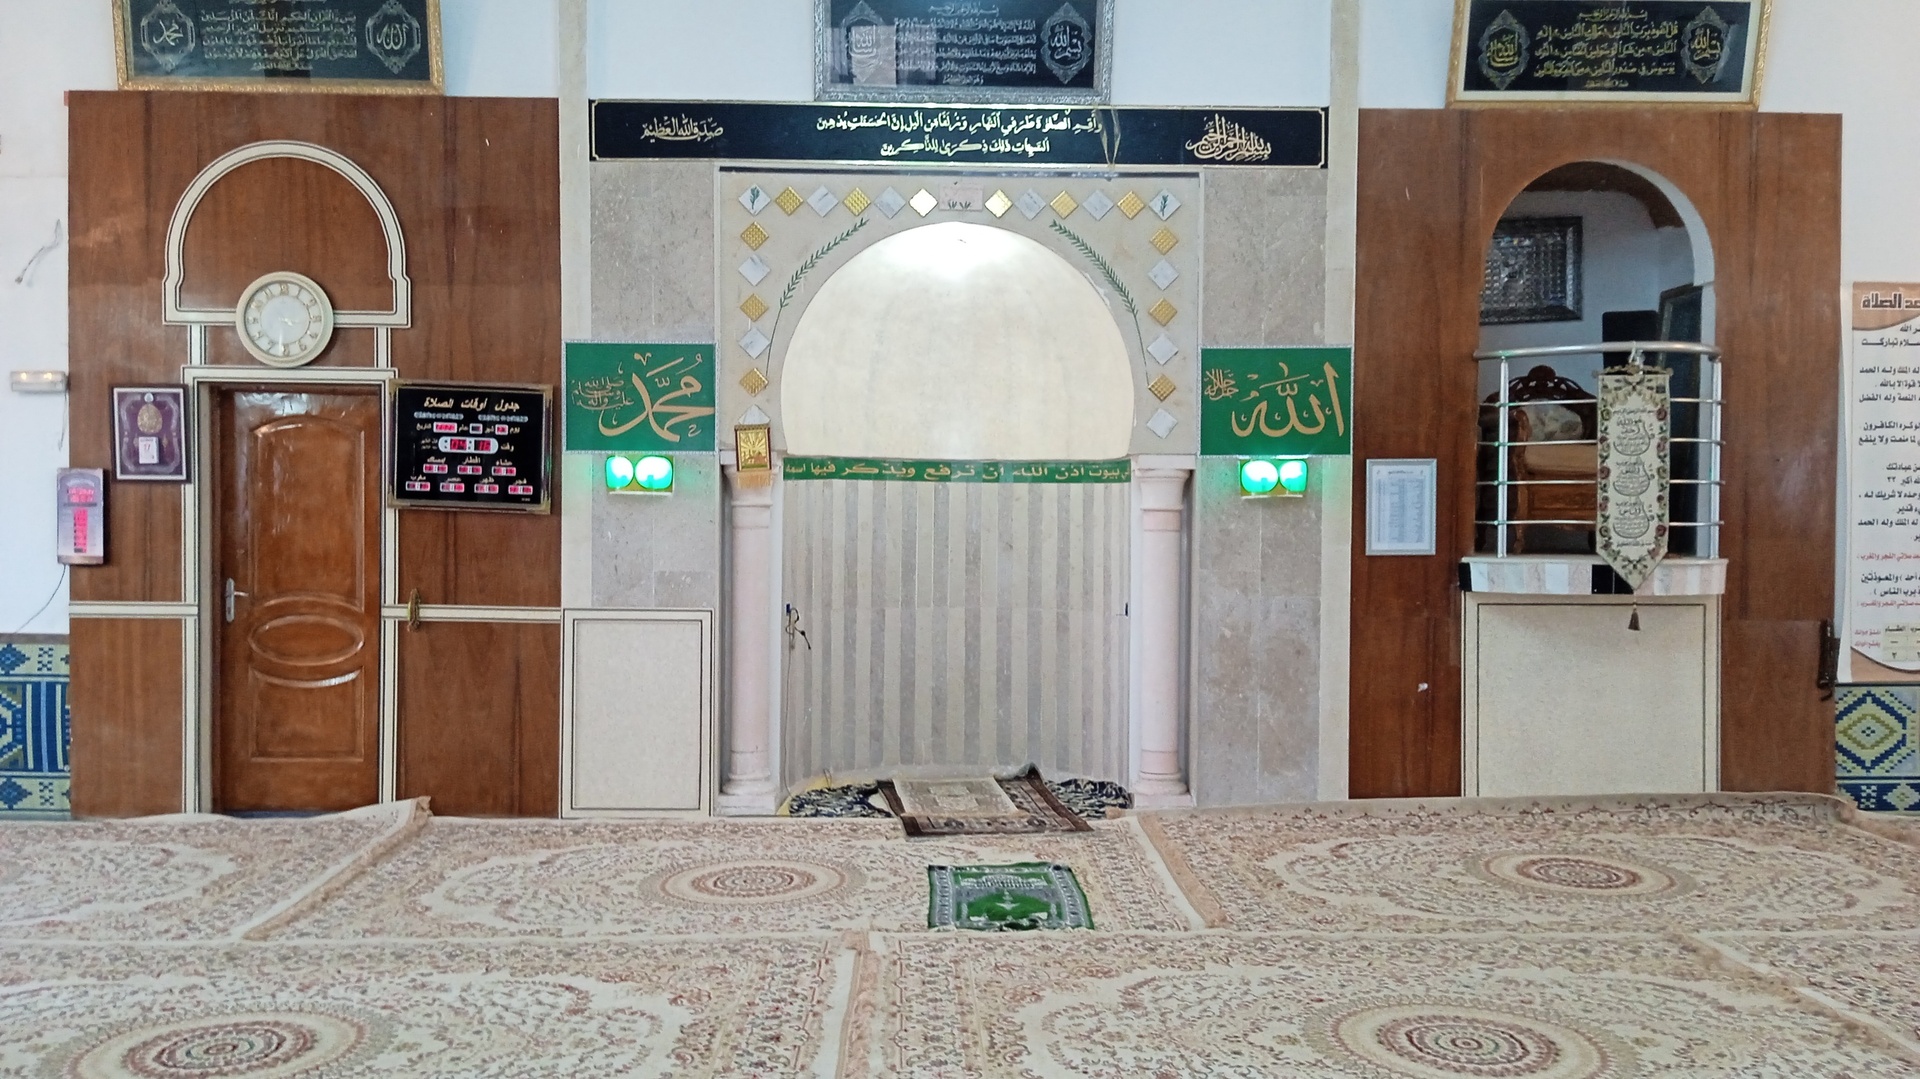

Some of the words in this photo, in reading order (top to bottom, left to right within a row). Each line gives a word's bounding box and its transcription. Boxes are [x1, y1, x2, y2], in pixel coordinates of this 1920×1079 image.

[377, 23, 409, 50] الله
[1050, 26, 1069, 48] الله
[1690, 28, 1709, 48] الله
[969, 111, 1001, 134] النهار
[640, 116, 676, 143] العظيم
[1862, 292, 1902, 309] الصلاة
[1900, 324, 1912, 332] الله
[1861, 337, 1898, 347] تباركت
[1859, 365, 1880, 373] الحمد
[1881, 365, 1896, 375] وله
[424, 397, 454, 409] الصلاة
[599, 354, 715, 442] محمد
[1231, 362, 1345, 437] الله
[1859, 392, 1881, 403] الفضل
[1884, 393, 1896, 403] وله
[495, 399, 521, 412] جدول
[1863, 420, 1899, 431] الكافرون
[1858, 434, 1876, 446] ينفع
[1876, 434, 1889, 445] ولا
[1890, 434, 1909, 443] منعت
[500, 442, 514, 453] وقت
[811, 462, 836, 476] فيها
[924, 464, 975, 480] ترفع
[1012, 465, 1048, 476] الله
[1089, 465, 1120, 479] بيوت
[1886, 462, 1912, 473] عبادتك
[1875, 489, 1896, 500] شريك
[1896, 503, 1914, 515] قدير
[1858, 518, 1879, 526] الحمد
[1881, 518, 1894, 528] وله
[1880, 587, 1902, 597] الناس
